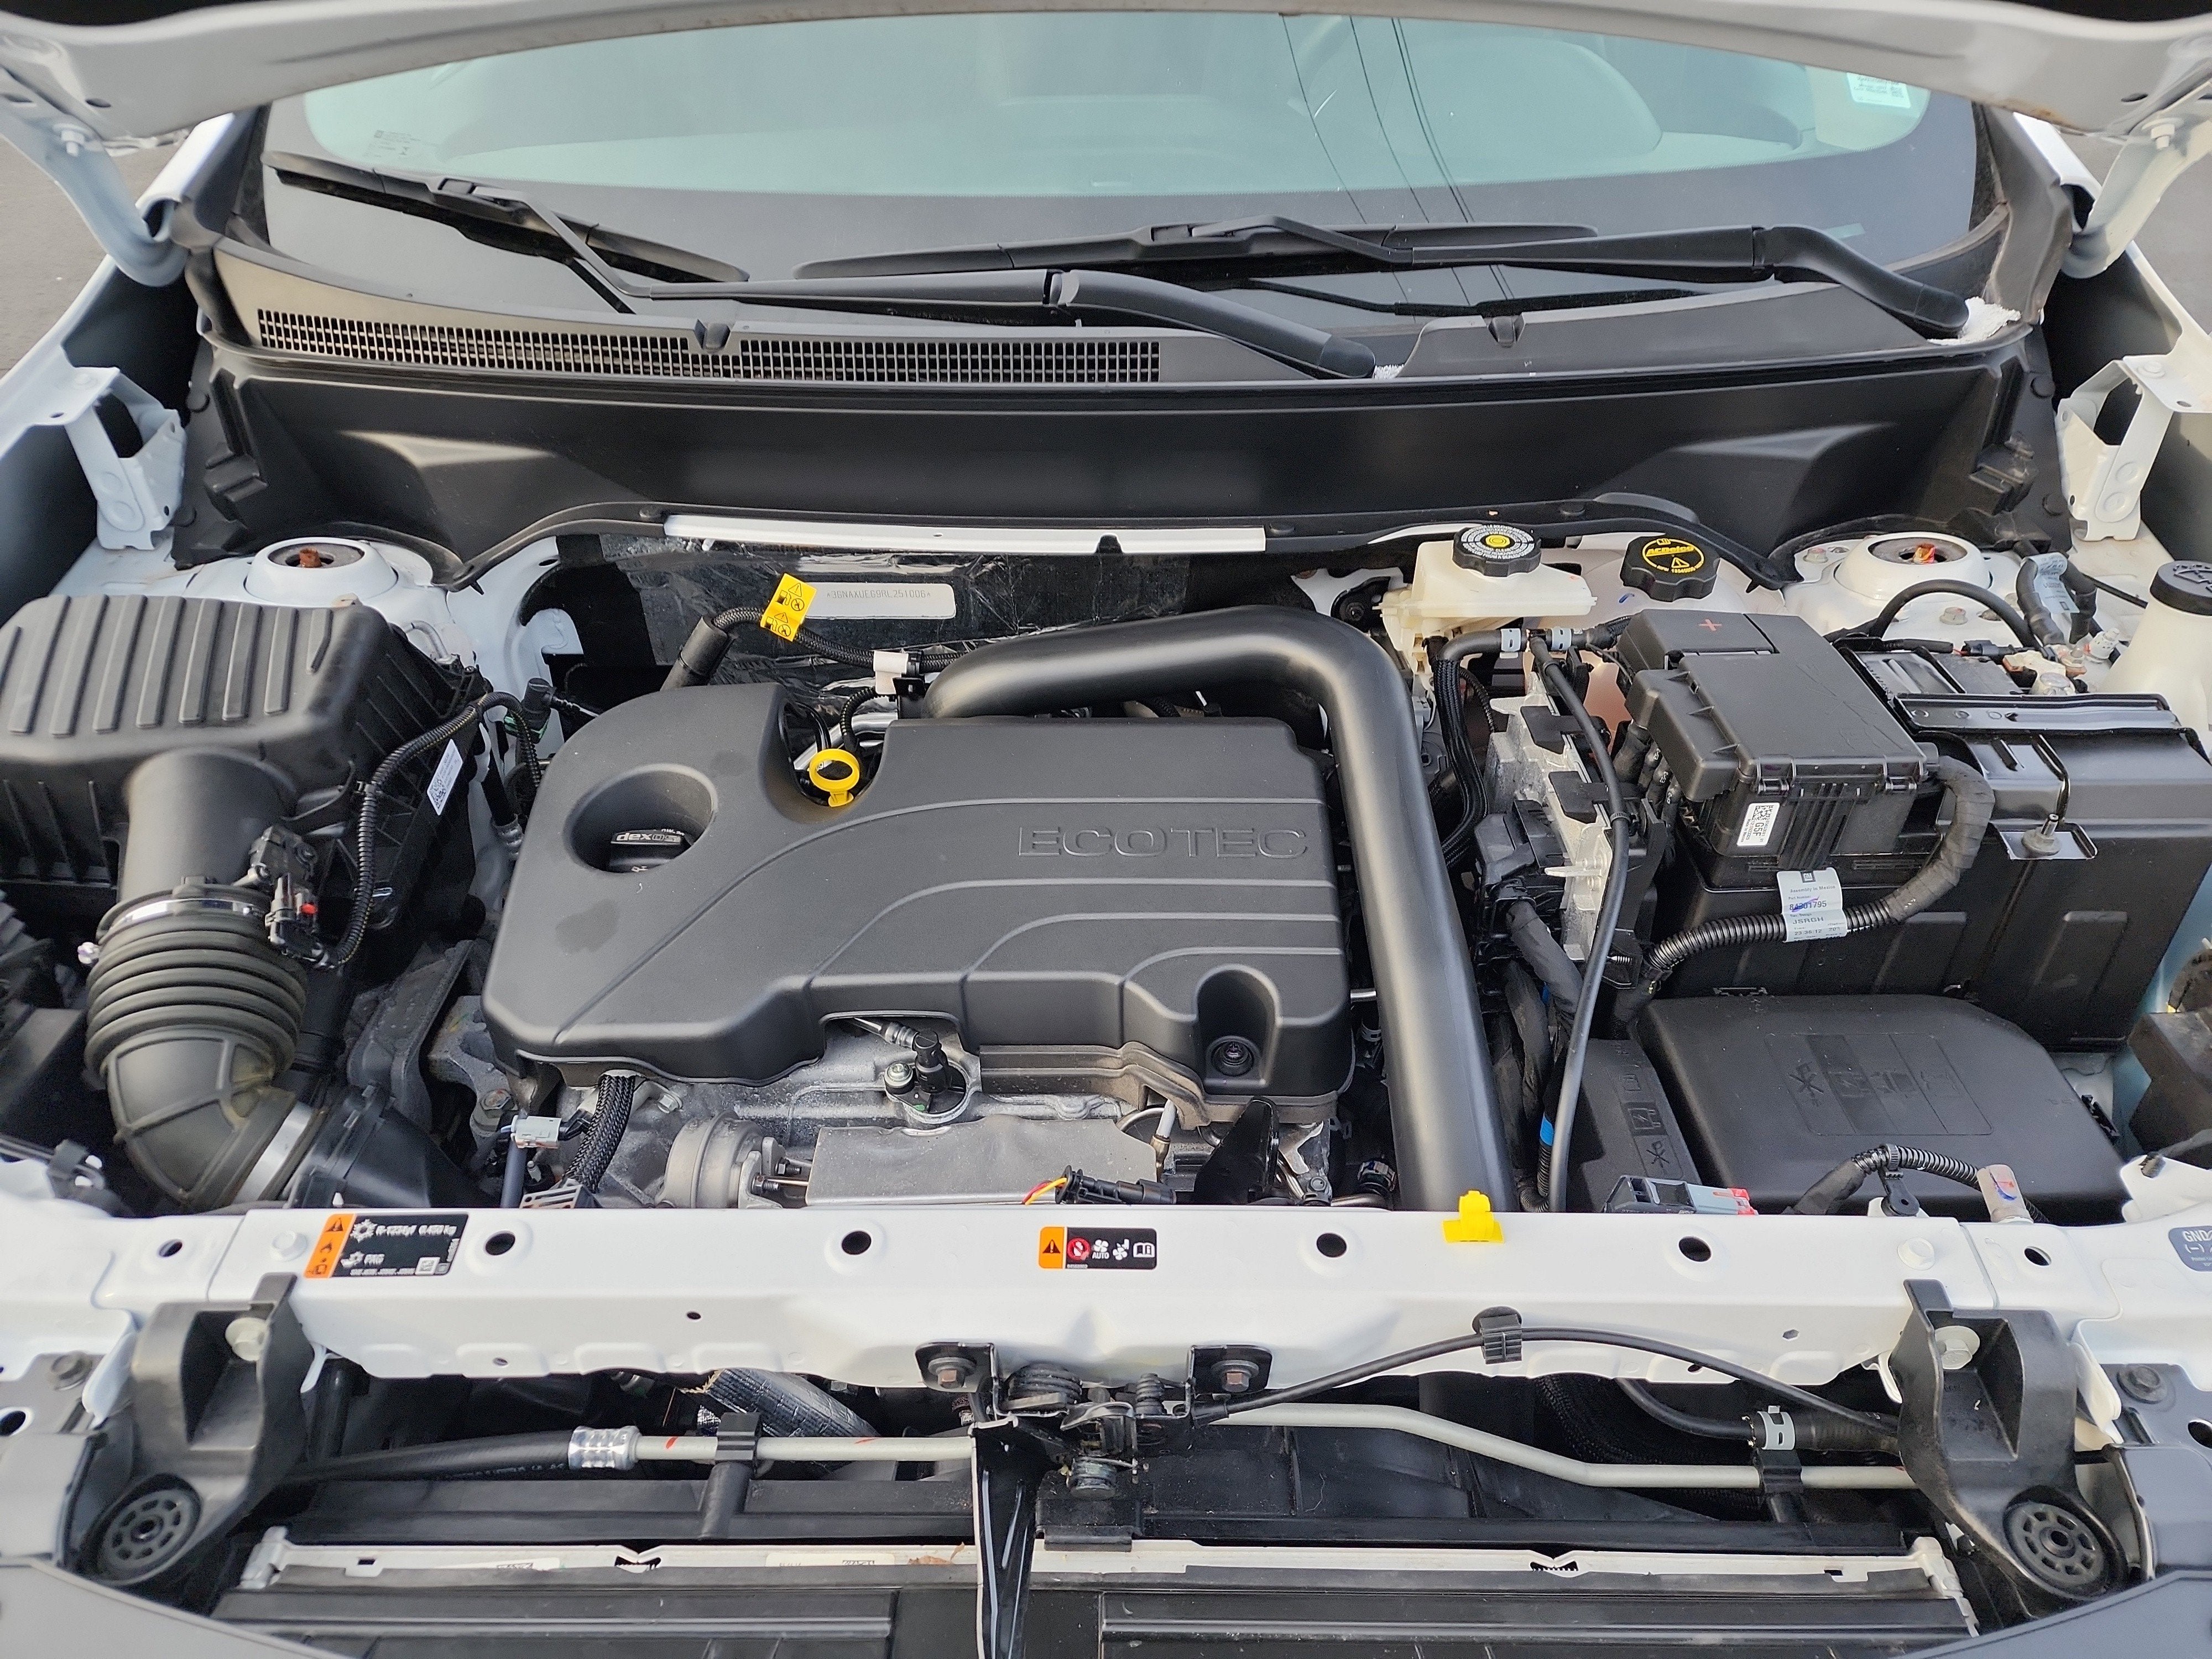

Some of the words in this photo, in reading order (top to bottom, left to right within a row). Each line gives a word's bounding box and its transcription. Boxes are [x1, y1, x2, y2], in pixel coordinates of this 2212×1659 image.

[1646, 546, 1694, 555] ACDelco
[1018, 827, 1309, 859] ECOTEC
[1792, 916, 1824, 925] JSRGH
